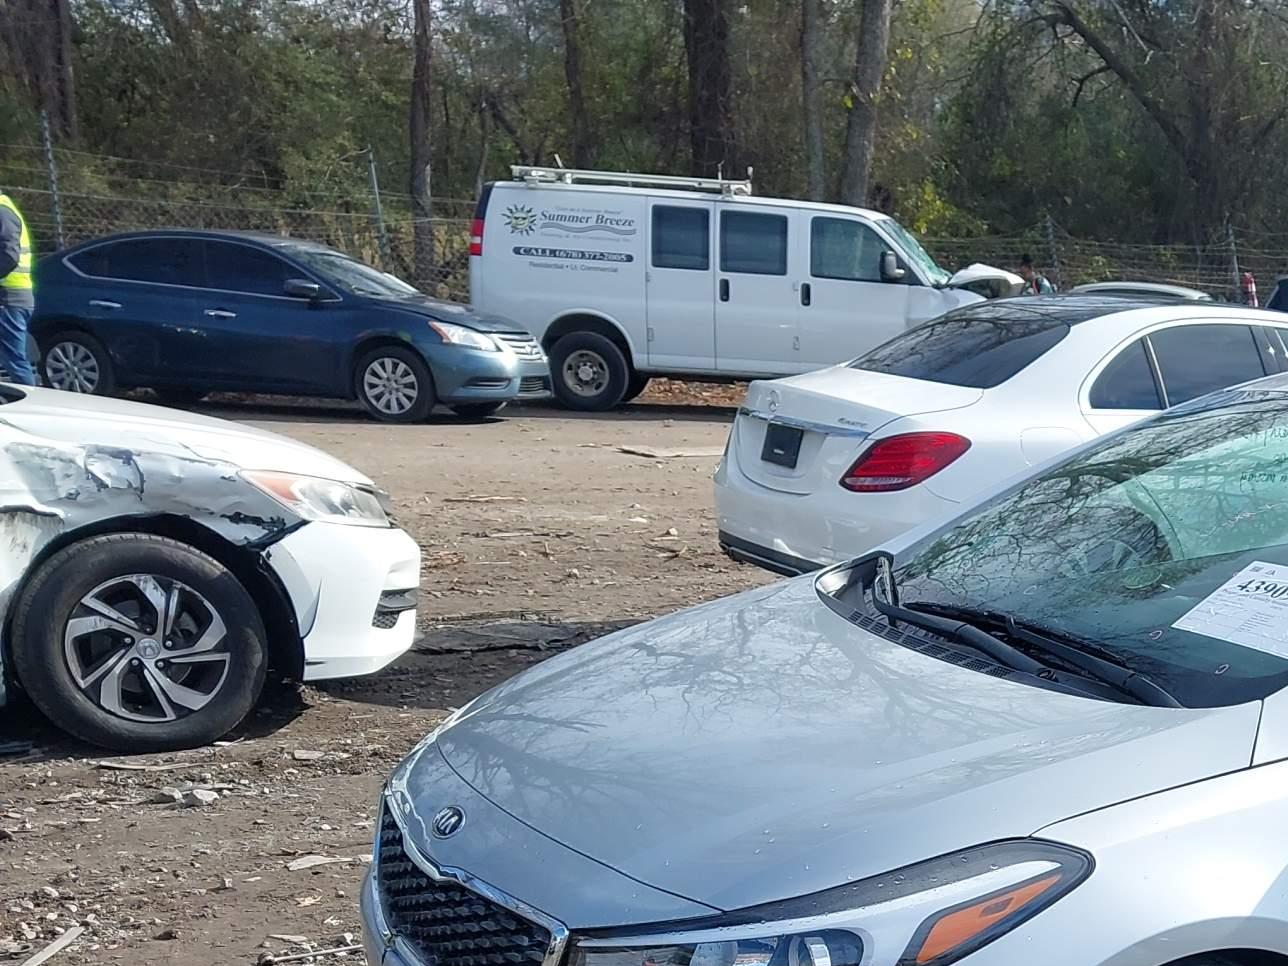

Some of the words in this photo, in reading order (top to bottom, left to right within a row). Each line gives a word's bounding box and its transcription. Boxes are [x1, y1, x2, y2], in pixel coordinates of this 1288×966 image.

[540, 210, 592, 224] Summer
[595, 214, 635, 227] Breeze
[519, 247, 554, 258] CALL
